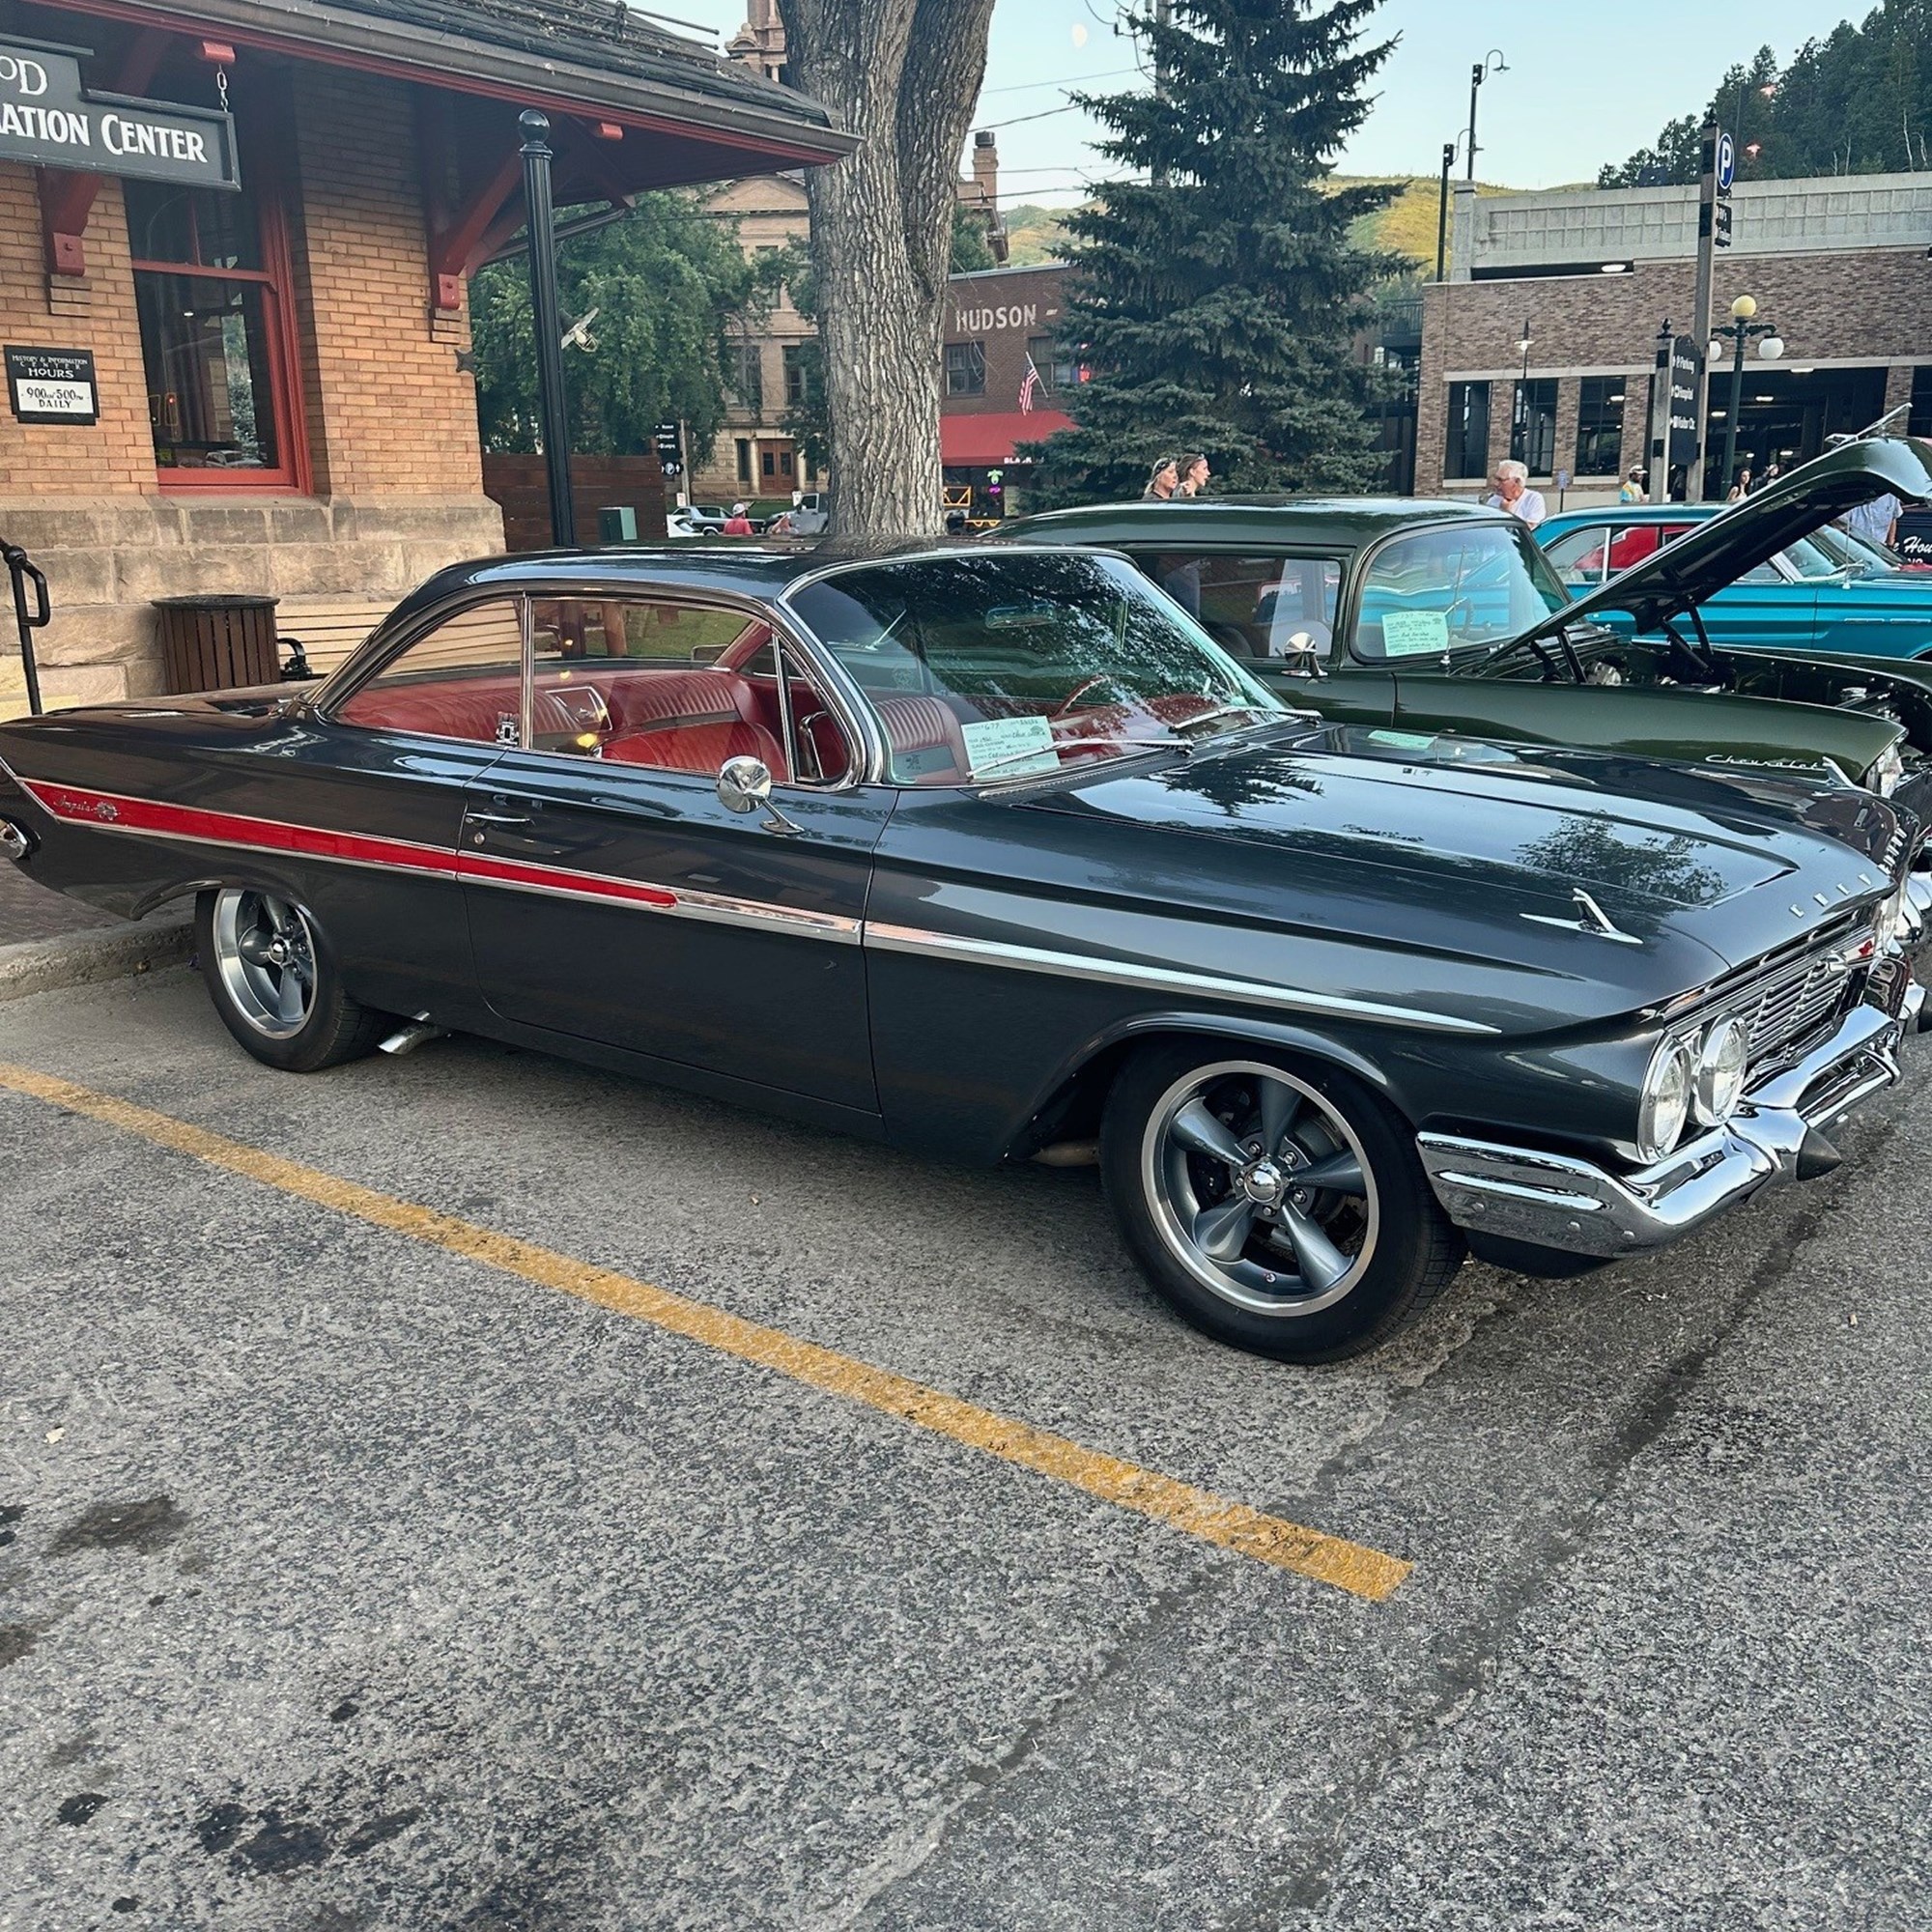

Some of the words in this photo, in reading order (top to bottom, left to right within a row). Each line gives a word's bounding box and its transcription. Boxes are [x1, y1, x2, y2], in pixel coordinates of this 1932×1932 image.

[0, 102, 91, 146] ATION
[100, 114, 208, 163] CENTER
[1721, 140, 1732, 182] P
[956, 304, 1037, 332] HUDSON
[20, 361, 81, 370] CENTER
[47, 356, 88, 365] INFORMATION
[28, 367, 74, 379] HOURS
[39, 399, 71, 409] DAILY
[1705, 754, 1827, 772] Chevrolet
